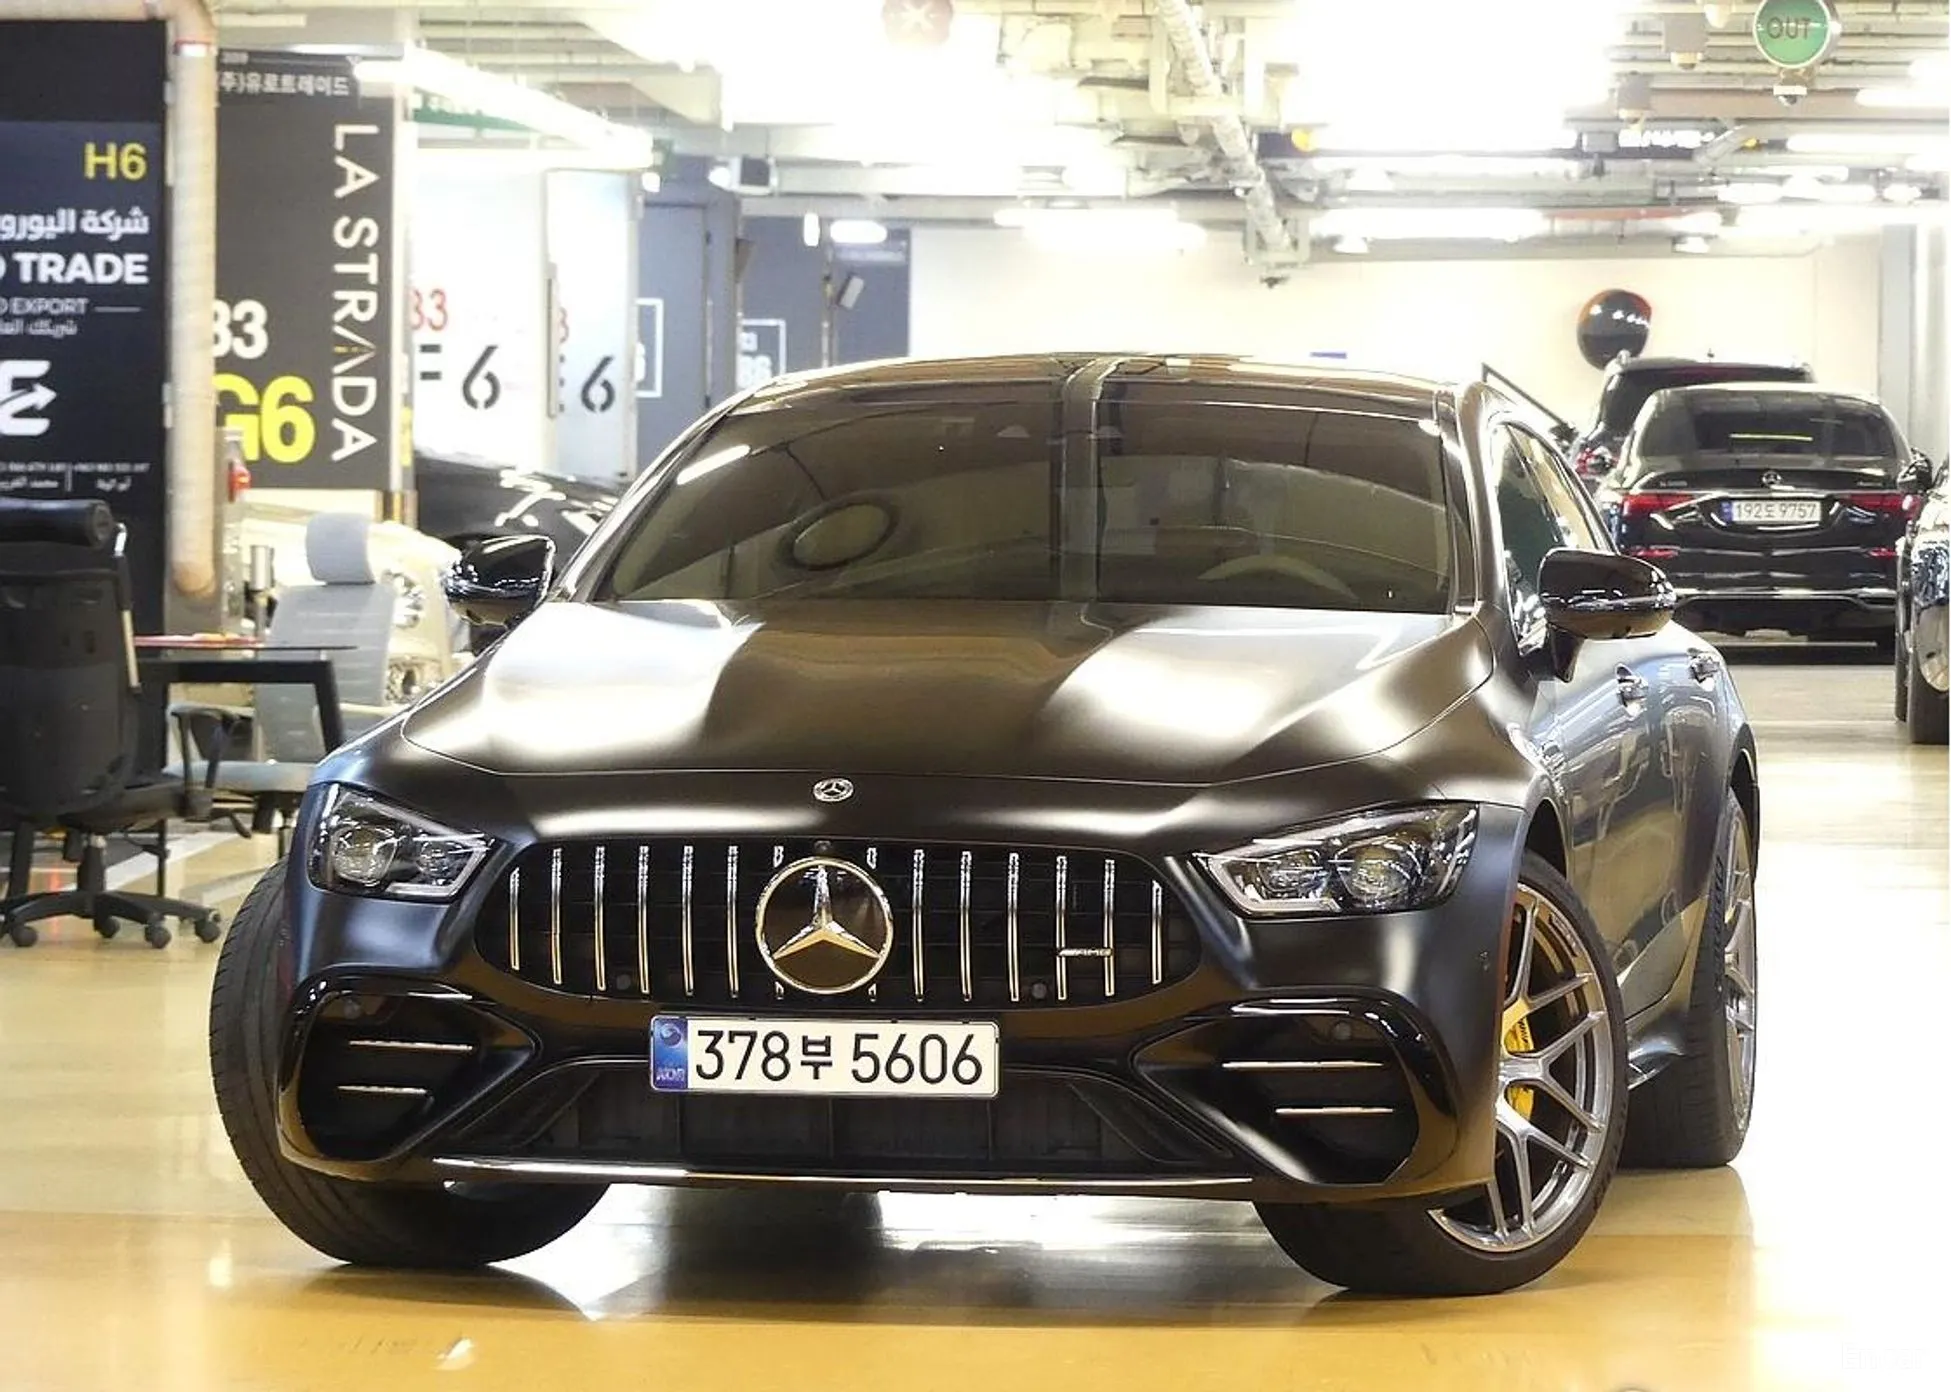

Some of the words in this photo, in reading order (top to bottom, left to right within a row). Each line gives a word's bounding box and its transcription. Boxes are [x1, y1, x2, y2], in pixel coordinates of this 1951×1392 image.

[1766, 16, 1811, 39] OUT
[220, 70, 349, 96] 주)유로트레이드
[84, 143, 147, 180] H6
[333, 124, 380, 199] LA
[80, 206, 150, 241] شركة
[12, 252, 150, 284] TRADE
[331, 216, 380, 462] STRADA
[1780, 502, 1817, 518] 9757
[695, 1030, 833, 1082] 378부
[851, 1032, 983, 1085] 5606
